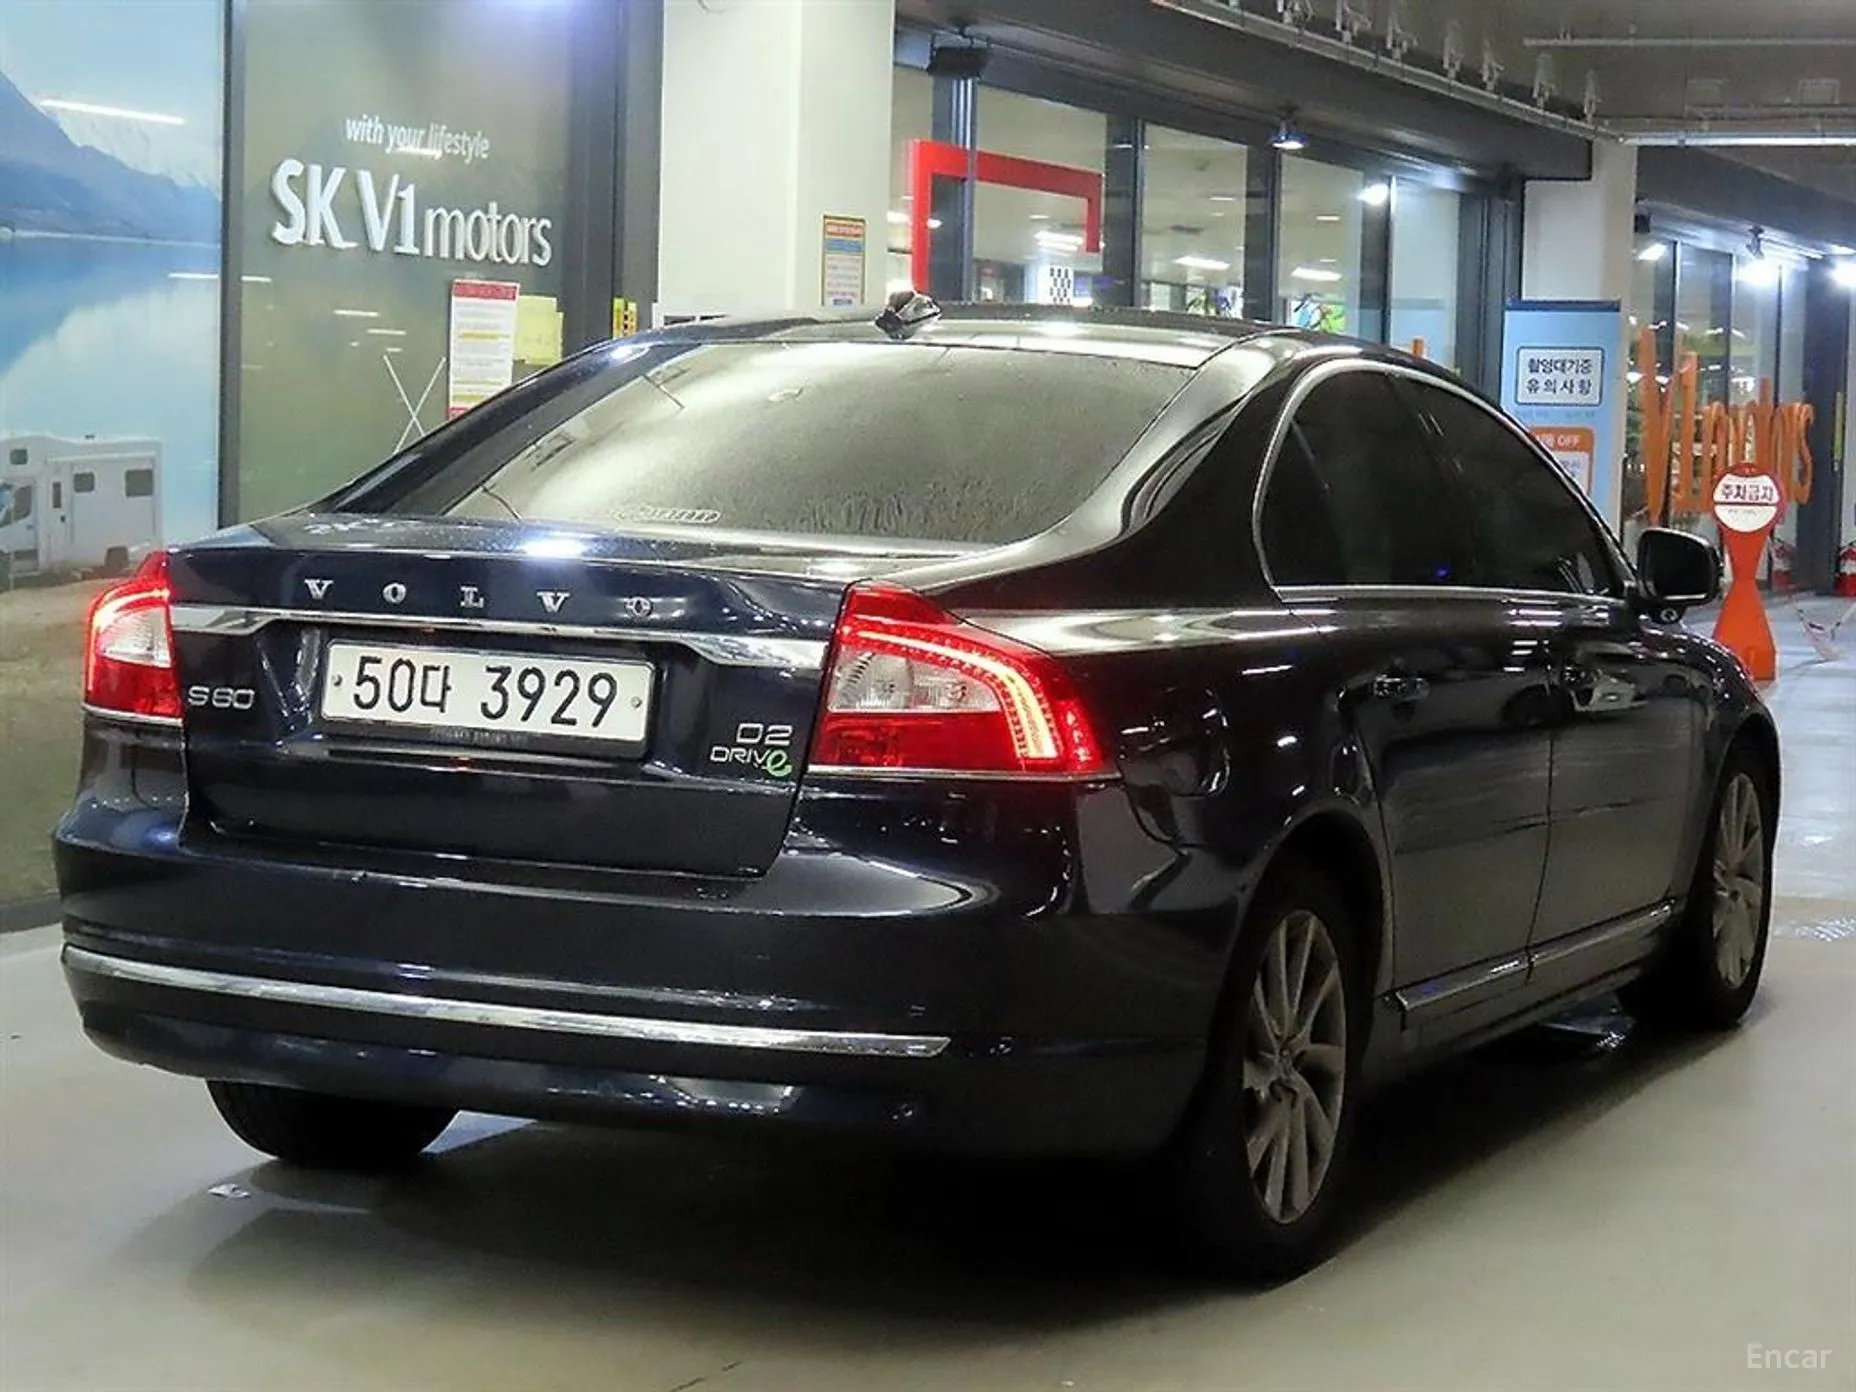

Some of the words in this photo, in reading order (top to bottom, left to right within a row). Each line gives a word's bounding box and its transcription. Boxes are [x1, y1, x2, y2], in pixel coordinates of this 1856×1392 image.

[345, 113, 385, 144] with
[384, 123, 426, 154] your
[427, 121, 491, 165] lifestyle
[270, 158, 352, 250] SK
[1721, 483, 1774, 502] 주차금지
[304, 578, 653, 618] VOLVO
[353, 655, 452, 714] 50다
[480, 665, 618, 728] 3929
[736, 722, 794, 746] D2
